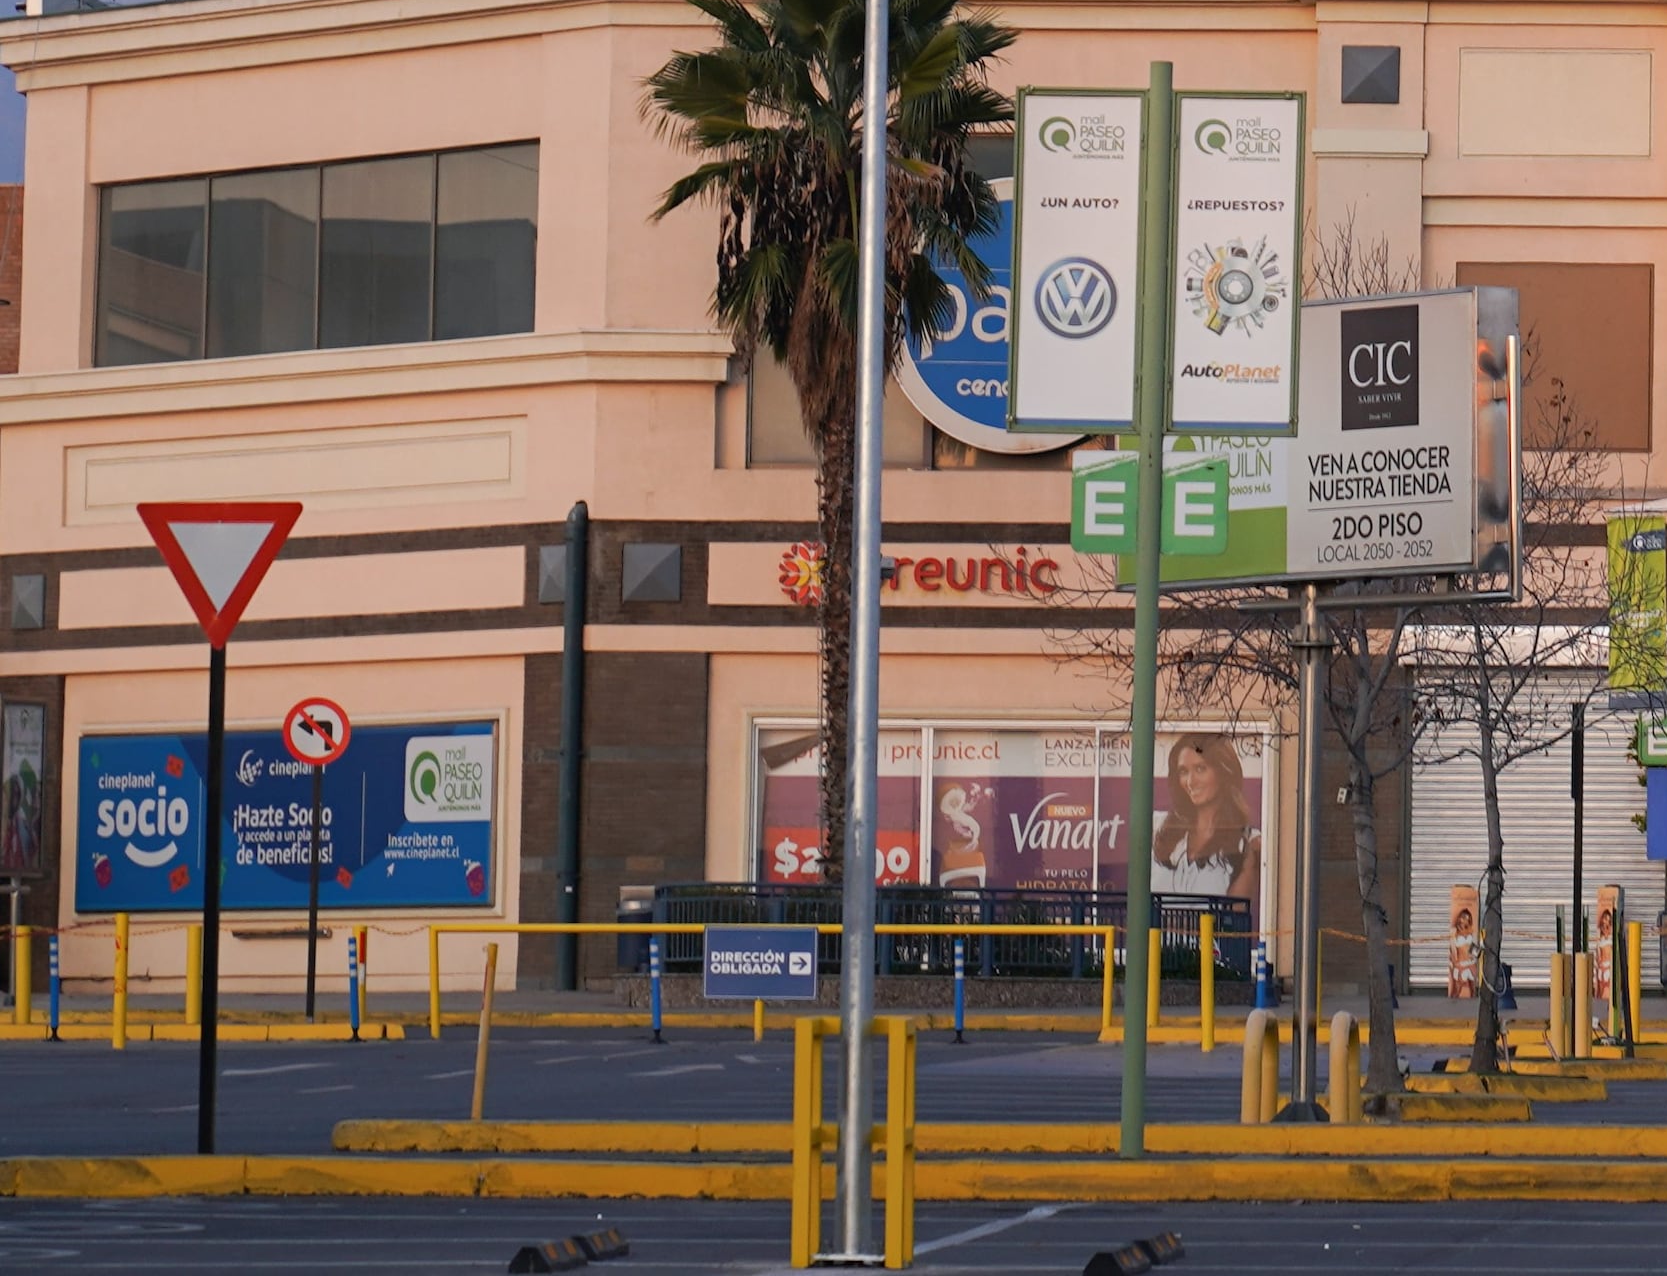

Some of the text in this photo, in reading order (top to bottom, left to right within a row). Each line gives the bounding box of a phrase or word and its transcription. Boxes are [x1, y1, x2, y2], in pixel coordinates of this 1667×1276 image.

[1080, 115, 1105, 124] mall
[1236, 117, 1260, 127] mall
[1080, 125, 1125, 139] PASEO
[1236, 128, 1281, 141] PASEO
[1040, 197, 1119, 209] ¿UN AUTO?
[1187, 199, 1285, 211] ¿REPUESTOS?
[1348, 340, 1411, 388] CIC
[1229, 448, 1272, 478] UILÍN
[1308, 445, 1450, 476] VEN A CONOCER
[1309, 471, 1452, 503] NUESTRA TIENDA
[1084, 481, 1126, 536] E
[1174, 481, 1216, 537] E
[1332, 511, 1423, 541] 2DO PISO
[1317, 544, 1360, 564] LOCAL
[1363, 541, 1393, 561] 2050
[1403, 539, 1433, 559] 2052
[888, 546, 1059, 592] reunic
[98, 771, 155, 792] cineplanet
[444, 762, 482, 781] PASEO
[97, 785, 189, 838] socio
[233, 803, 285, 833] ¡Hazte
[1053, 805, 1087, 816] NUEVO
[1009, 791, 1125, 854] Vanart
[441, 835, 454, 846] en
[236, 842, 333, 865] de beneficis!
[384, 846, 460, 860] www.cineplanet.cl
[1063, 870, 1088, 878] PELO
[711, 949, 785, 963] DIRECCIÓN
[710, 962, 782, 975] OBLIGADA
